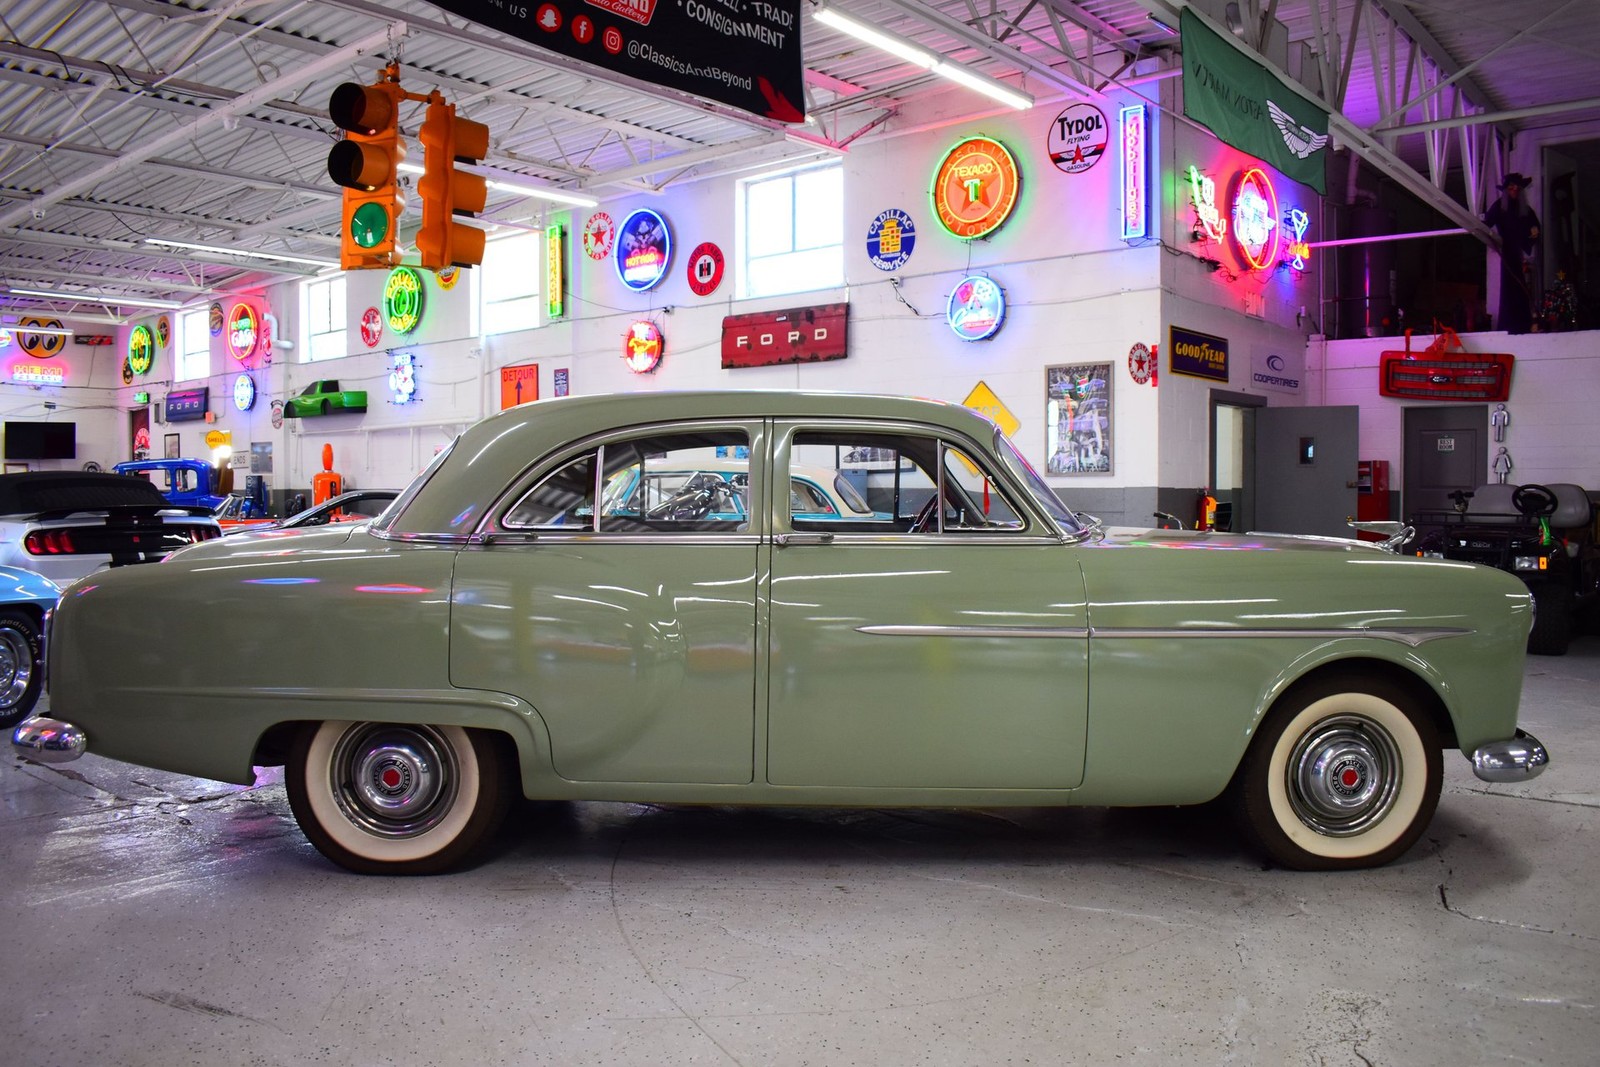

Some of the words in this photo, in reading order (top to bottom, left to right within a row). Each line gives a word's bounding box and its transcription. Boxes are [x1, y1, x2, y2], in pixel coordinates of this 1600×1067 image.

[509, 4, 528, 18] US
[611, 1, 647, 23] Gallery
[717, 0, 739, 13] ELL
[687, 0, 785, 49] CONSIGNMENT
[627, 40, 752, 90] @ClassicsAndBeyond
[1058, 115, 1102, 140] TYDOL
[1066, 134, 1091, 145] FLYING
[953, 162, 994, 177] TEXACO
[1066, 162, 1091, 171] GASOLINE
[870, 210, 913, 235] CADILLAC
[938, 202, 989, 237] MOTOR
[872, 252, 909, 270] SERVICE
[736, 328, 827, 348] FORD
[503, 368, 534, 382] DETOUR
[169, 401, 199, 411] FORD
[234, 455, 246, 464] ENDS
